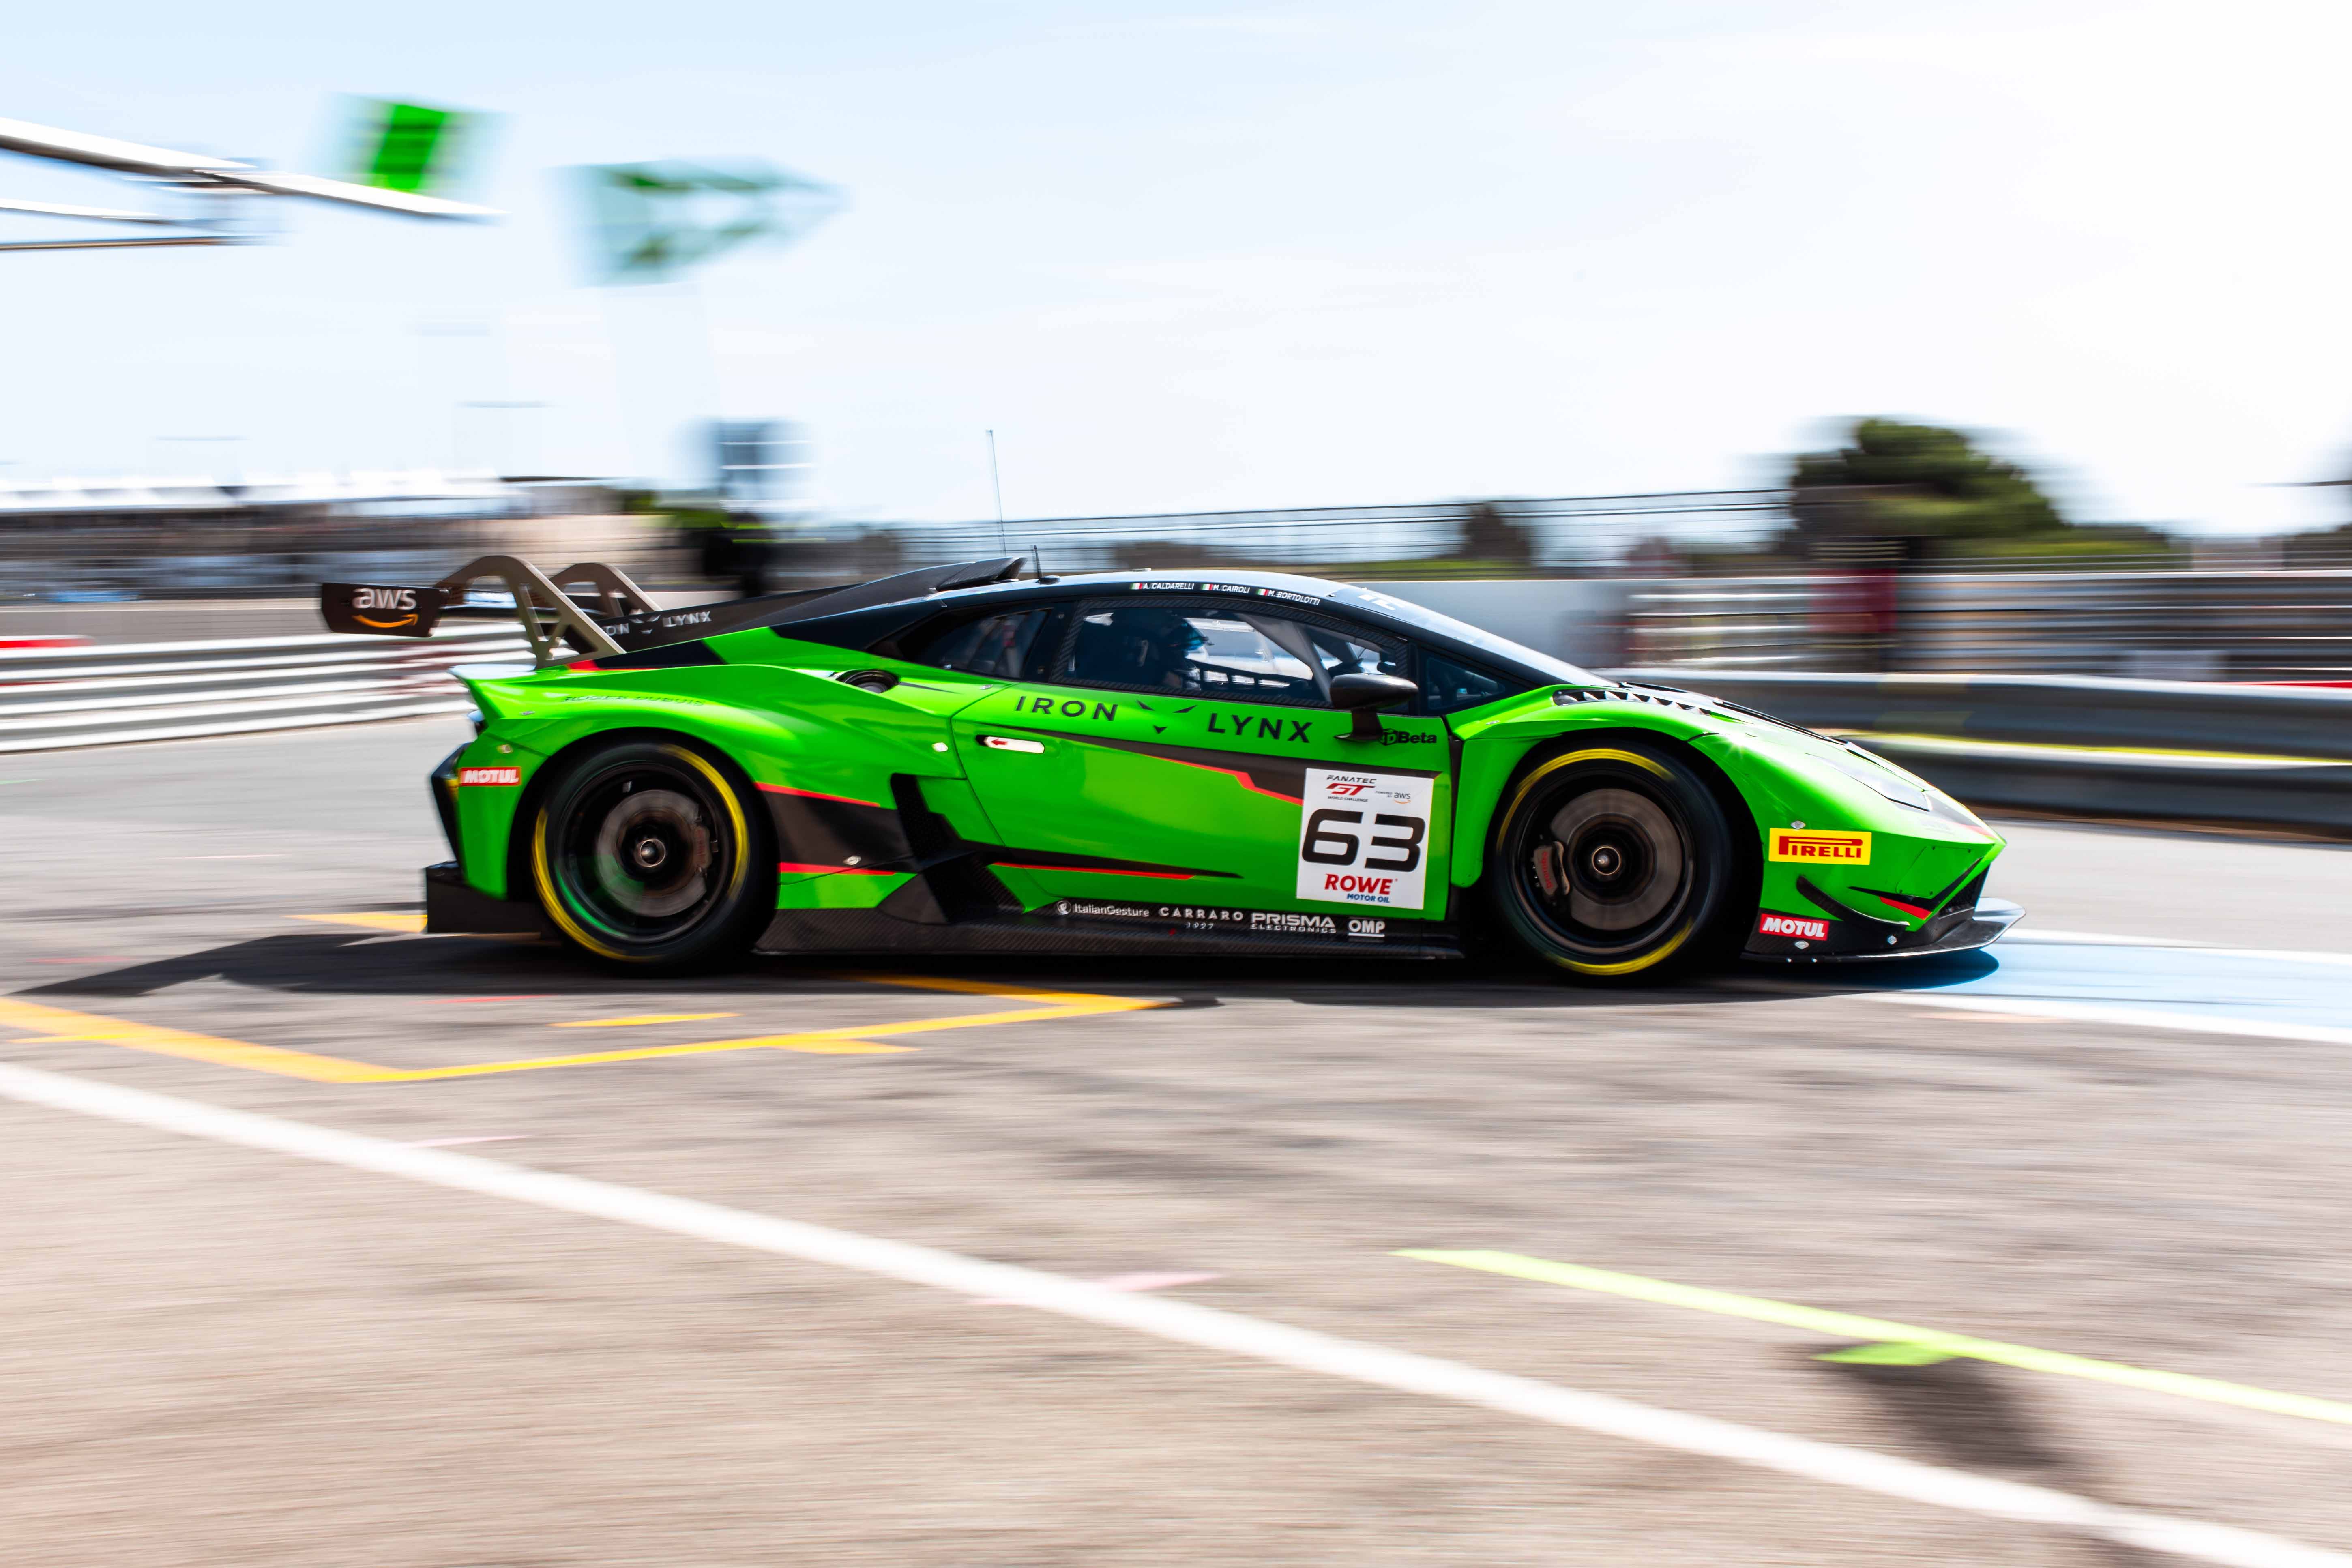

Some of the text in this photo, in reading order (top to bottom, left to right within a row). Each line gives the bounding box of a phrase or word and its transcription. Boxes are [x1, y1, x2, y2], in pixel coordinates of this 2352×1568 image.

[352, 588, 417, 610] aws
[1221, 585, 1251, 594] CAIROLI
[1277, 591, 1320, 605] BORTOLOTTI
[664, 611, 712, 628] LYNX
[1015, 696, 1313, 743] IRON LYNX
[464, 769, 519, 784] MOTUL
[1326, 775, 1377, 784] FANATEC
[1326, 783, 1376, 796] GT
[1394, 792, 1411, 800] aws
[1302, 808, 1425, 873] 63
[1779, 836, 1863, 858] PIRELLI
[1324, 874, 1393, 895] ROWE
[1346, 893, 1376, 902] MOTOR
[1073, 903, 1150, 917] ItalianGesture
[1160, 907, 1244, 921] CARRARO
[1251, 912, 1336, 928] PRISMA
[1348, 919, 1386, 933] OMP
[1762, 916, 1825, 938] MOTUL
[1250, 923, 1337, 934] ELECTRONICS
